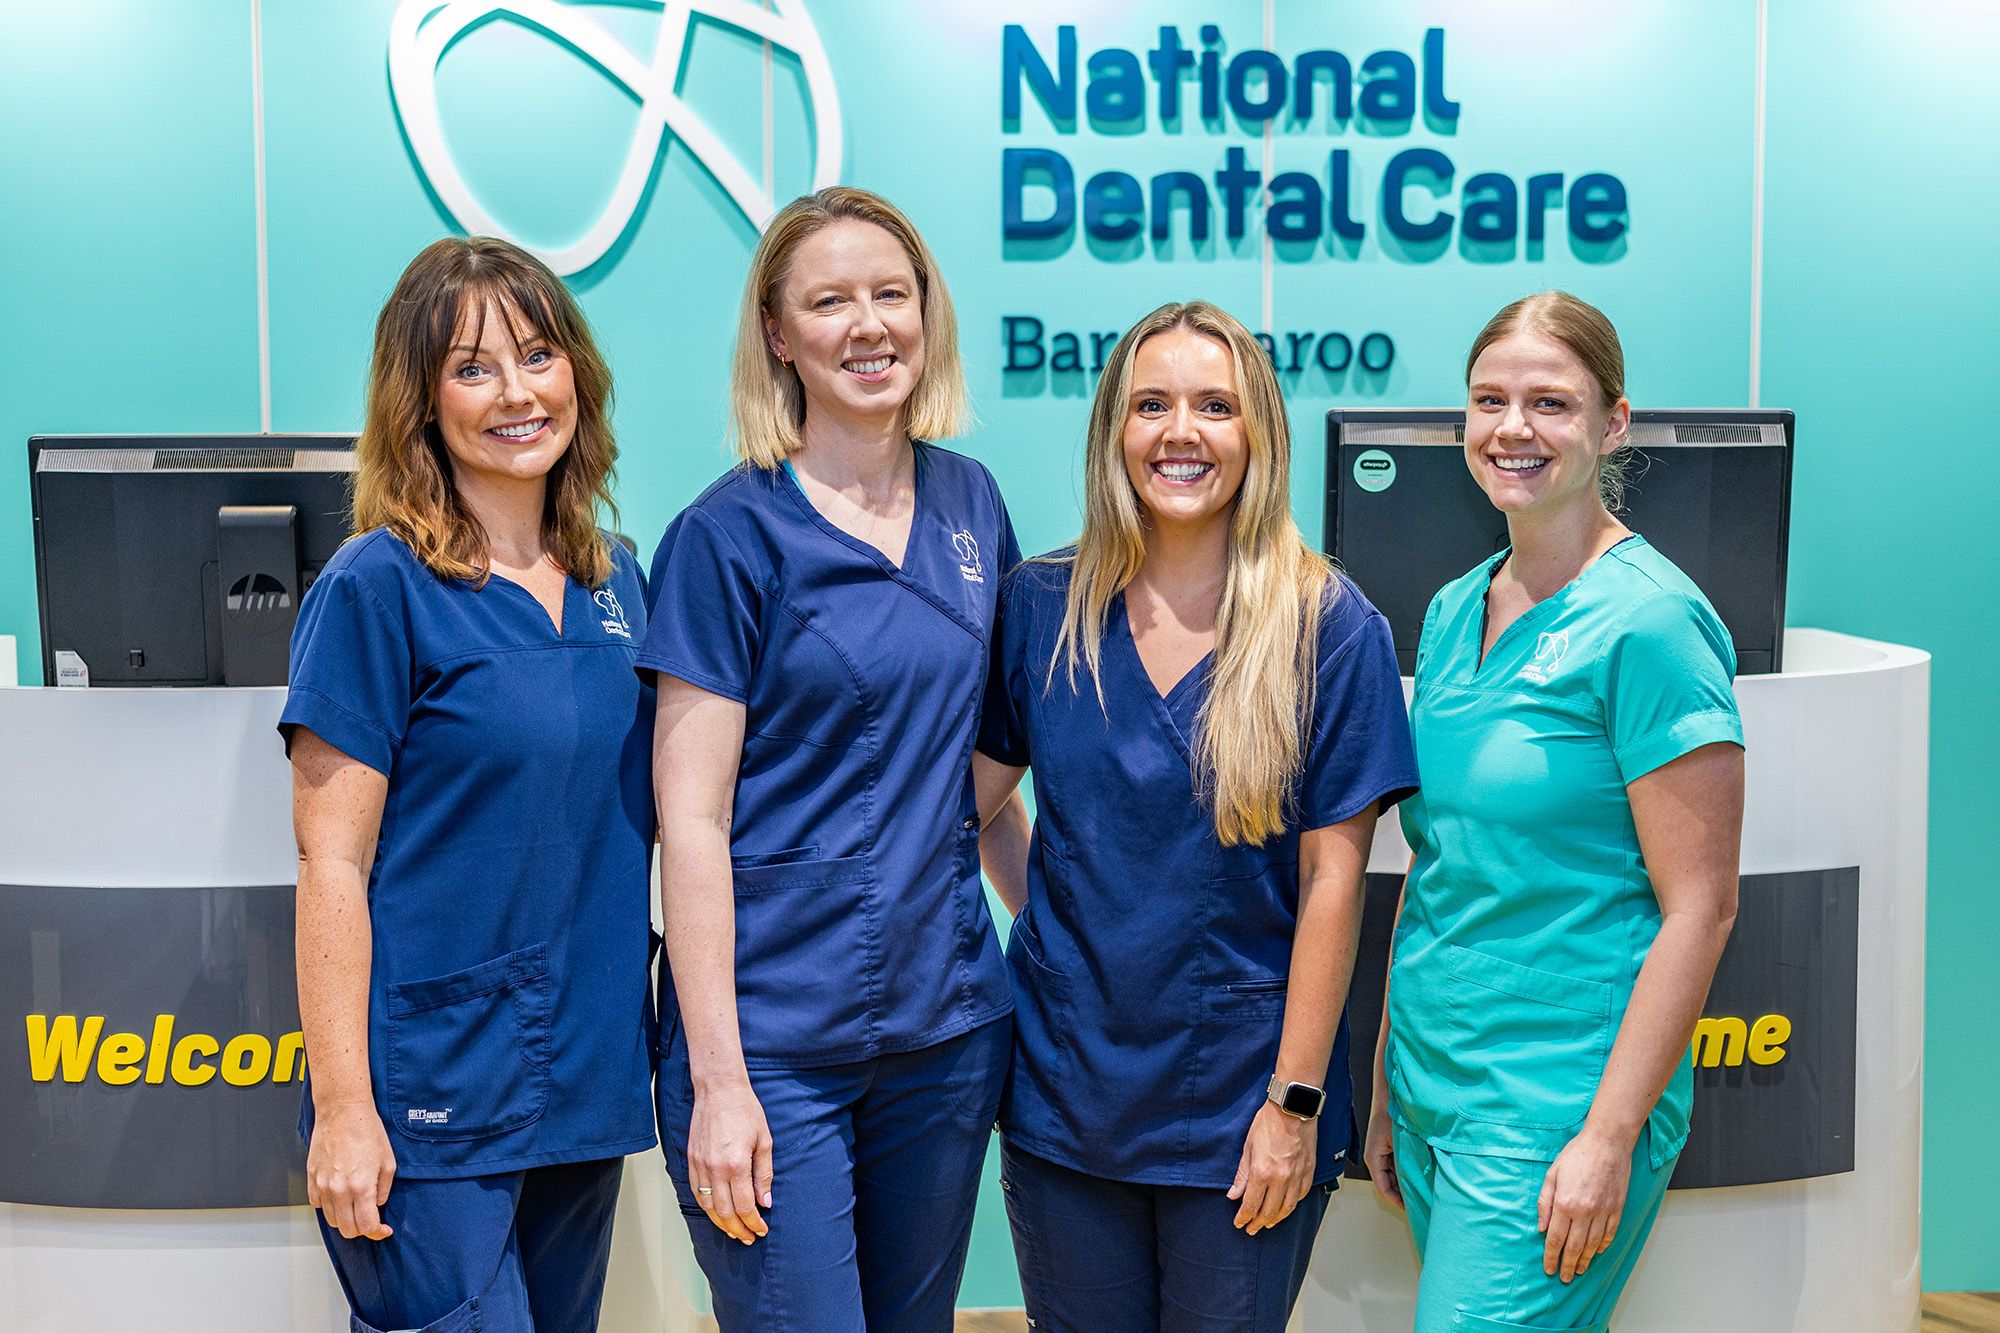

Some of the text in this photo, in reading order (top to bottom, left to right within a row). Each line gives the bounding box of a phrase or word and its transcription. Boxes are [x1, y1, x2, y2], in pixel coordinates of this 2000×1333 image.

[1002, 24, 1460, 121] National
[1002, 147, 1629, 243] Dental Care
[1002, 315, 1395, 372] Bararoo
